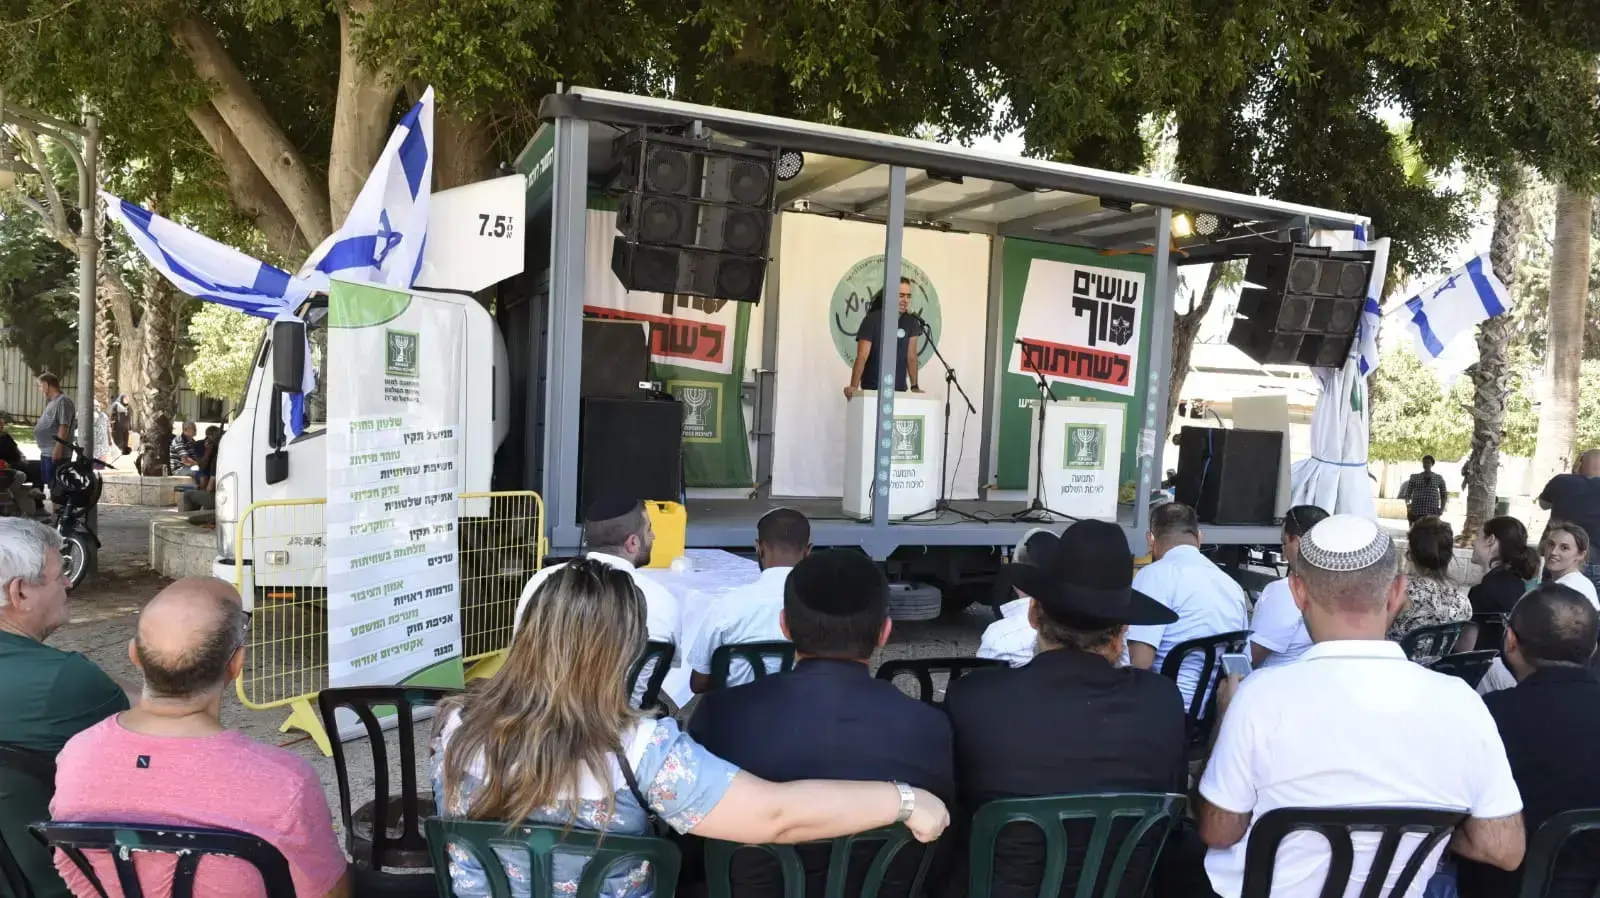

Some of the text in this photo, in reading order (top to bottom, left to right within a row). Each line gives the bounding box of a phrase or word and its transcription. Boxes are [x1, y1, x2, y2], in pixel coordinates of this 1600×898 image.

[479, 213, 514, 239] 7.5 TON
[1073, 269, 1139, 305] עושים
[1072, 295, 1136, 347] סוף
[1023, 342, 1130, 382] לשחיתות
[349, 416, 402, 434] שלטון החוק
[403, 432, 424, 445] תקין
[349, 452, 378, 466] מידות
[380, 460, 453, 480] חשיפת שחיתויות
[1071, 474, 1097, 483] התנועה
[350, 484, 400, 501] צדק חברתי
[384, 492, 453, 512] אתיקה שלטונית
[409, 526, 430, 541] תקין
[350, 543, 426, 569] מלחמה בשחיתות
[427, 553, 453, 567] ערכים
[350, 579, 404, 602] אמון הציבור
[393, 583, 453, 606] נורמות ראויות
[350, 608, 419, 637] מערכת המשפט
[406, 613, 453, 637] אכיפת חוק
[350, 637, 424, 669] אקטיביזם אזרחי
